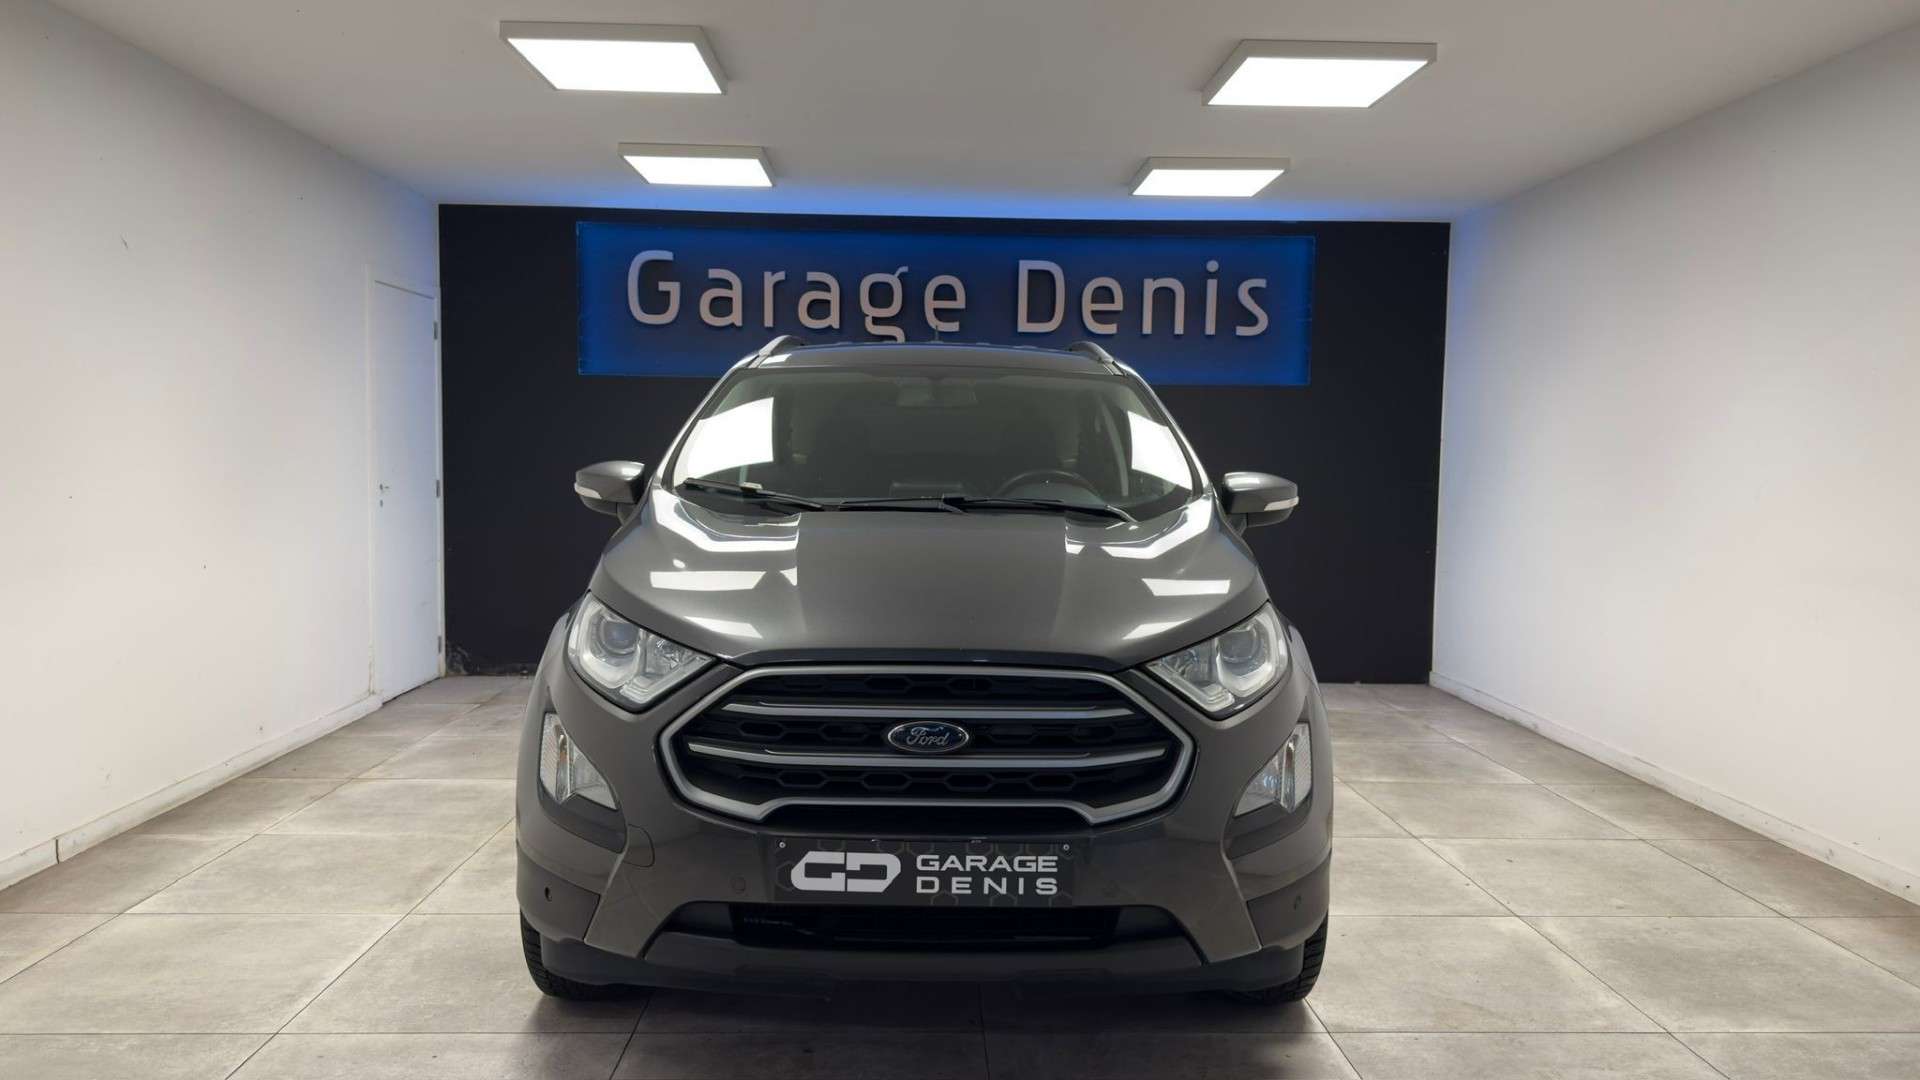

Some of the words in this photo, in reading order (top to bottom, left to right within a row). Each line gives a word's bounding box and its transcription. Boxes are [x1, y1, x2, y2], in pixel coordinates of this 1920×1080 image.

[626, 249, 967, 343] Garage
[1016, 259, 1270, 337] Denis
[906, 726, 950, 746] Ford
[916, 854, 1058, 872] GARAGE
[916, 876, 1058, 895] DENIS
